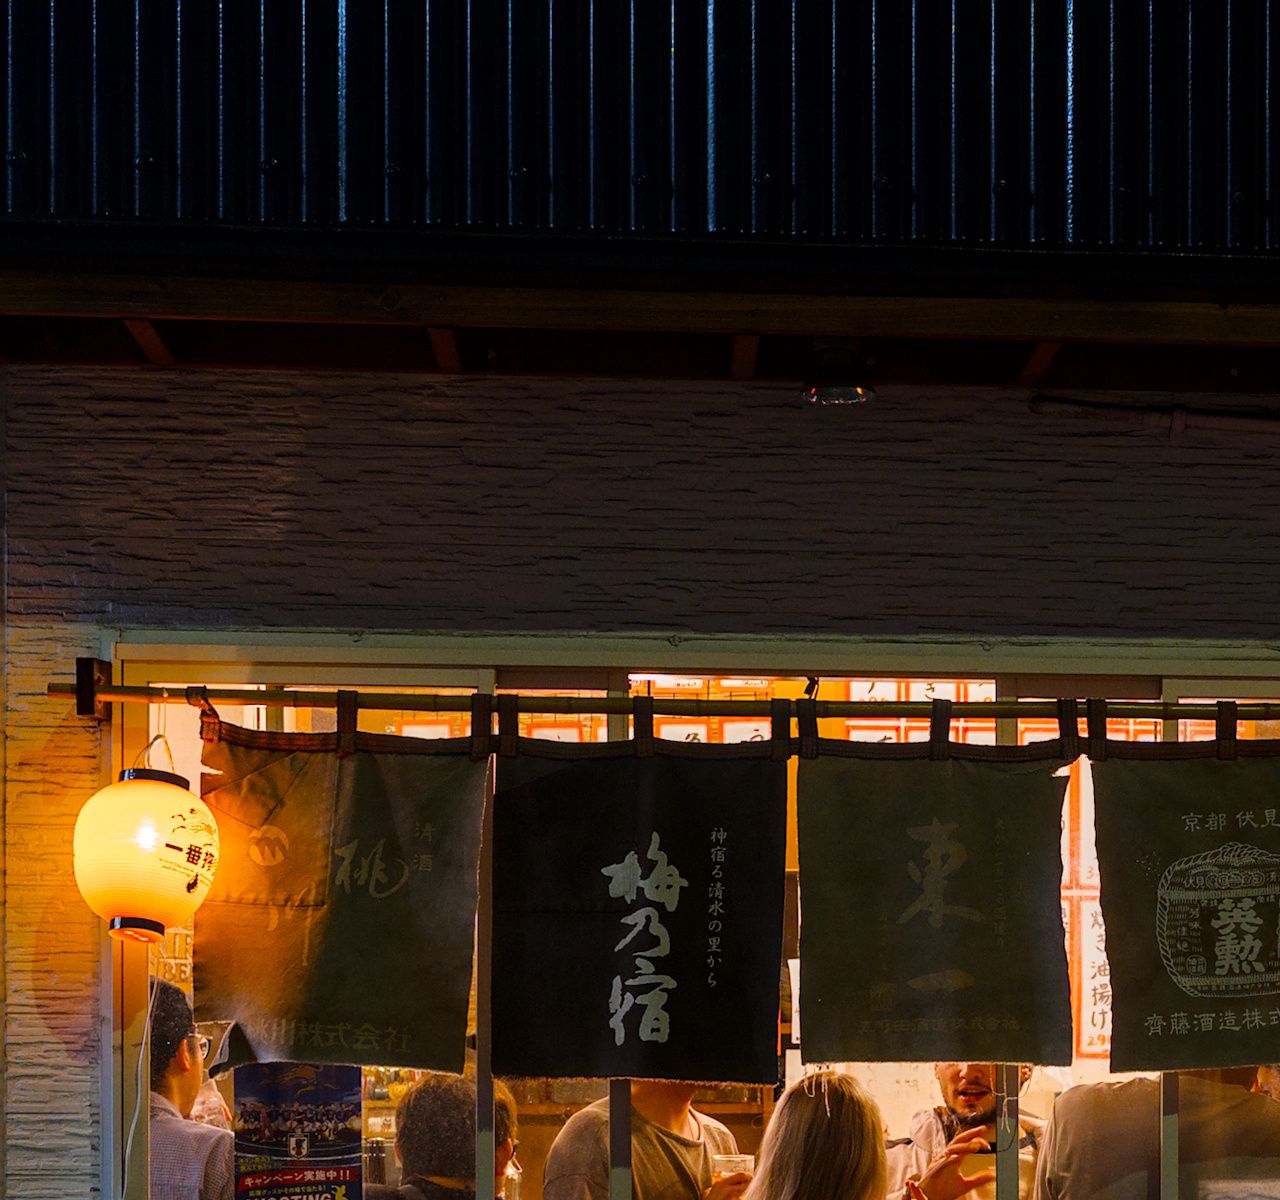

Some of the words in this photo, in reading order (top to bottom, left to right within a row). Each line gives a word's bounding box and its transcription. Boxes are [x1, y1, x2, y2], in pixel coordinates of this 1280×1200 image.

[1181, 812, 1227, 832] 京都
[600, 831, 689, 1046] 梅乃宿
[706, 827, 728, 987] 神宿る清水の里から
[1211, 897, 1266, 976] 英勲
[1087, 1035, 1111, 1048] 29
